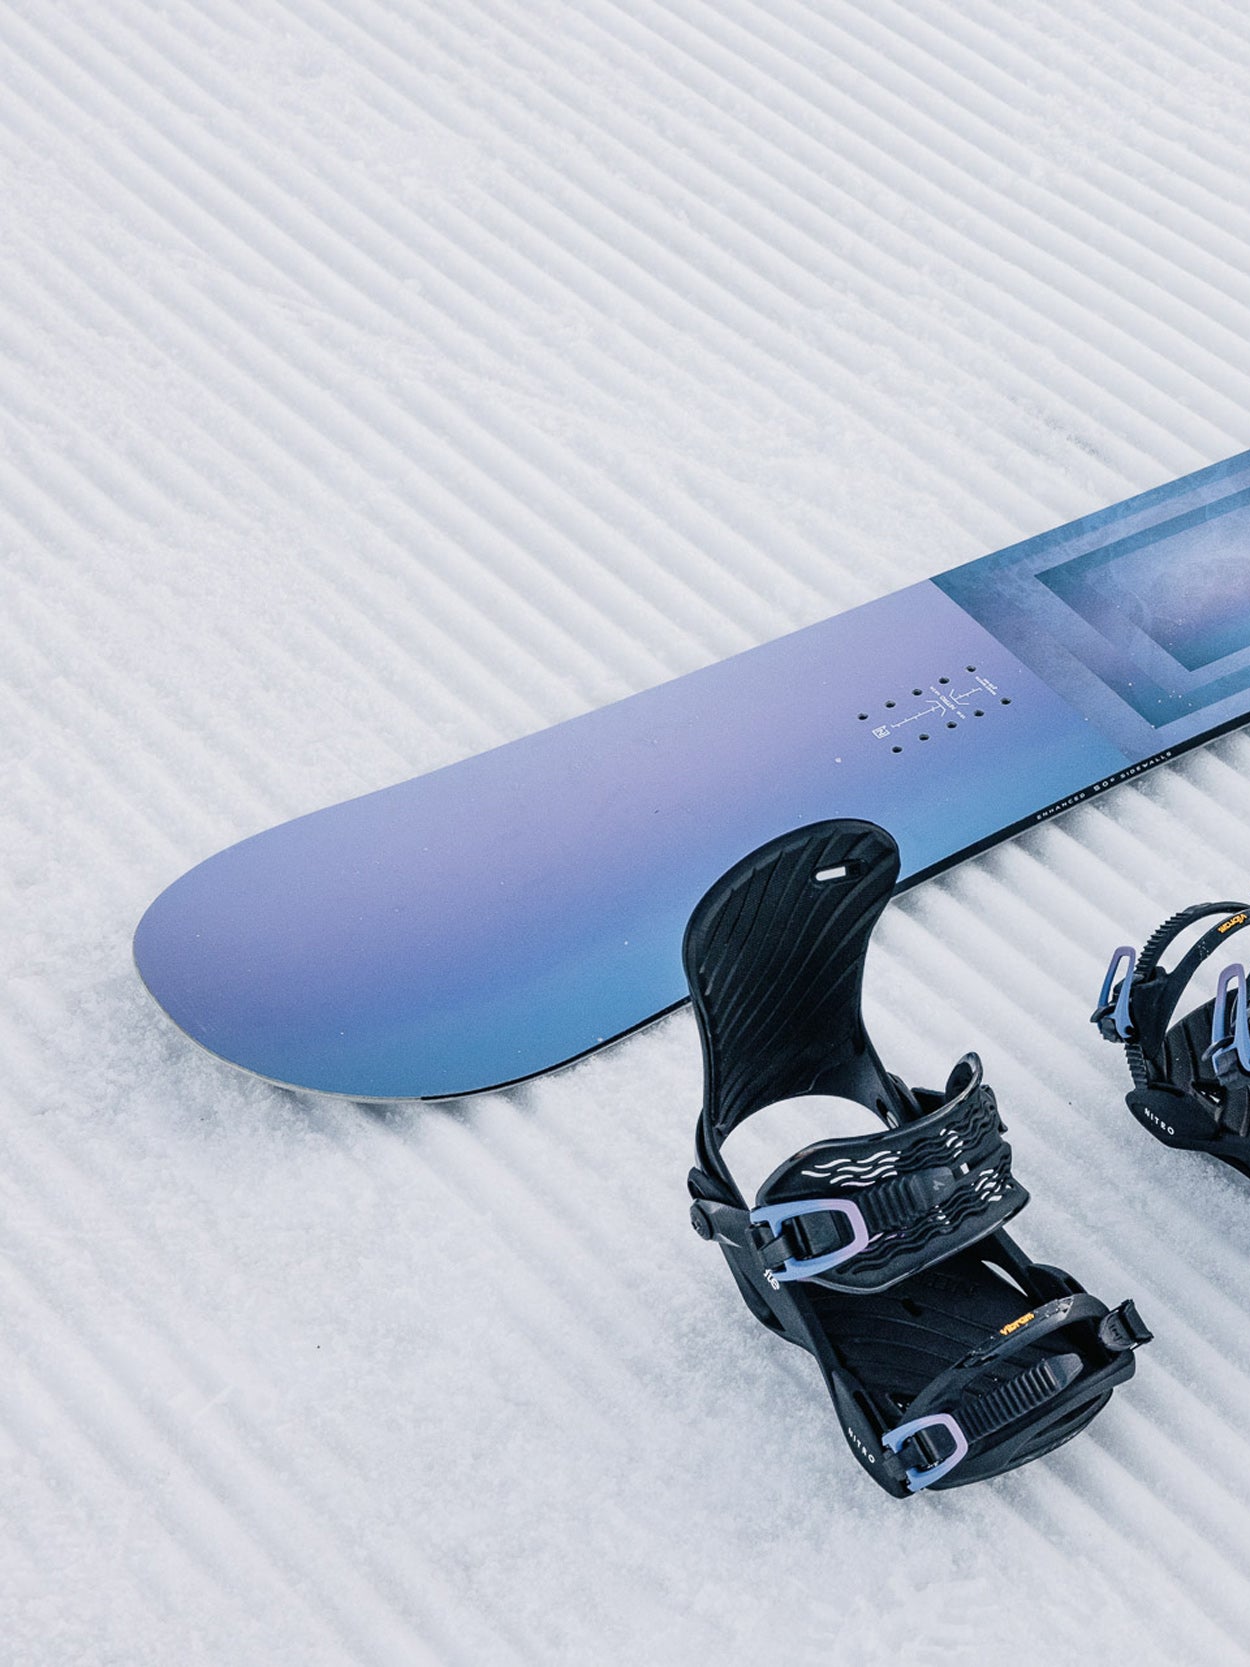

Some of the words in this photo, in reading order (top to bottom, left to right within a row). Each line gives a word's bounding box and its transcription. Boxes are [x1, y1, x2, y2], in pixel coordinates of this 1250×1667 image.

[1036, 792, 1086, 821] ENHANCED
[1119, 751, 1172, 779] SIDEWALLS
[1144, 1107, 1175, 1136] NITRO
[999, 1312, 1035, 1336] vibram
[848, 1427, 876, 1464] NITRO
